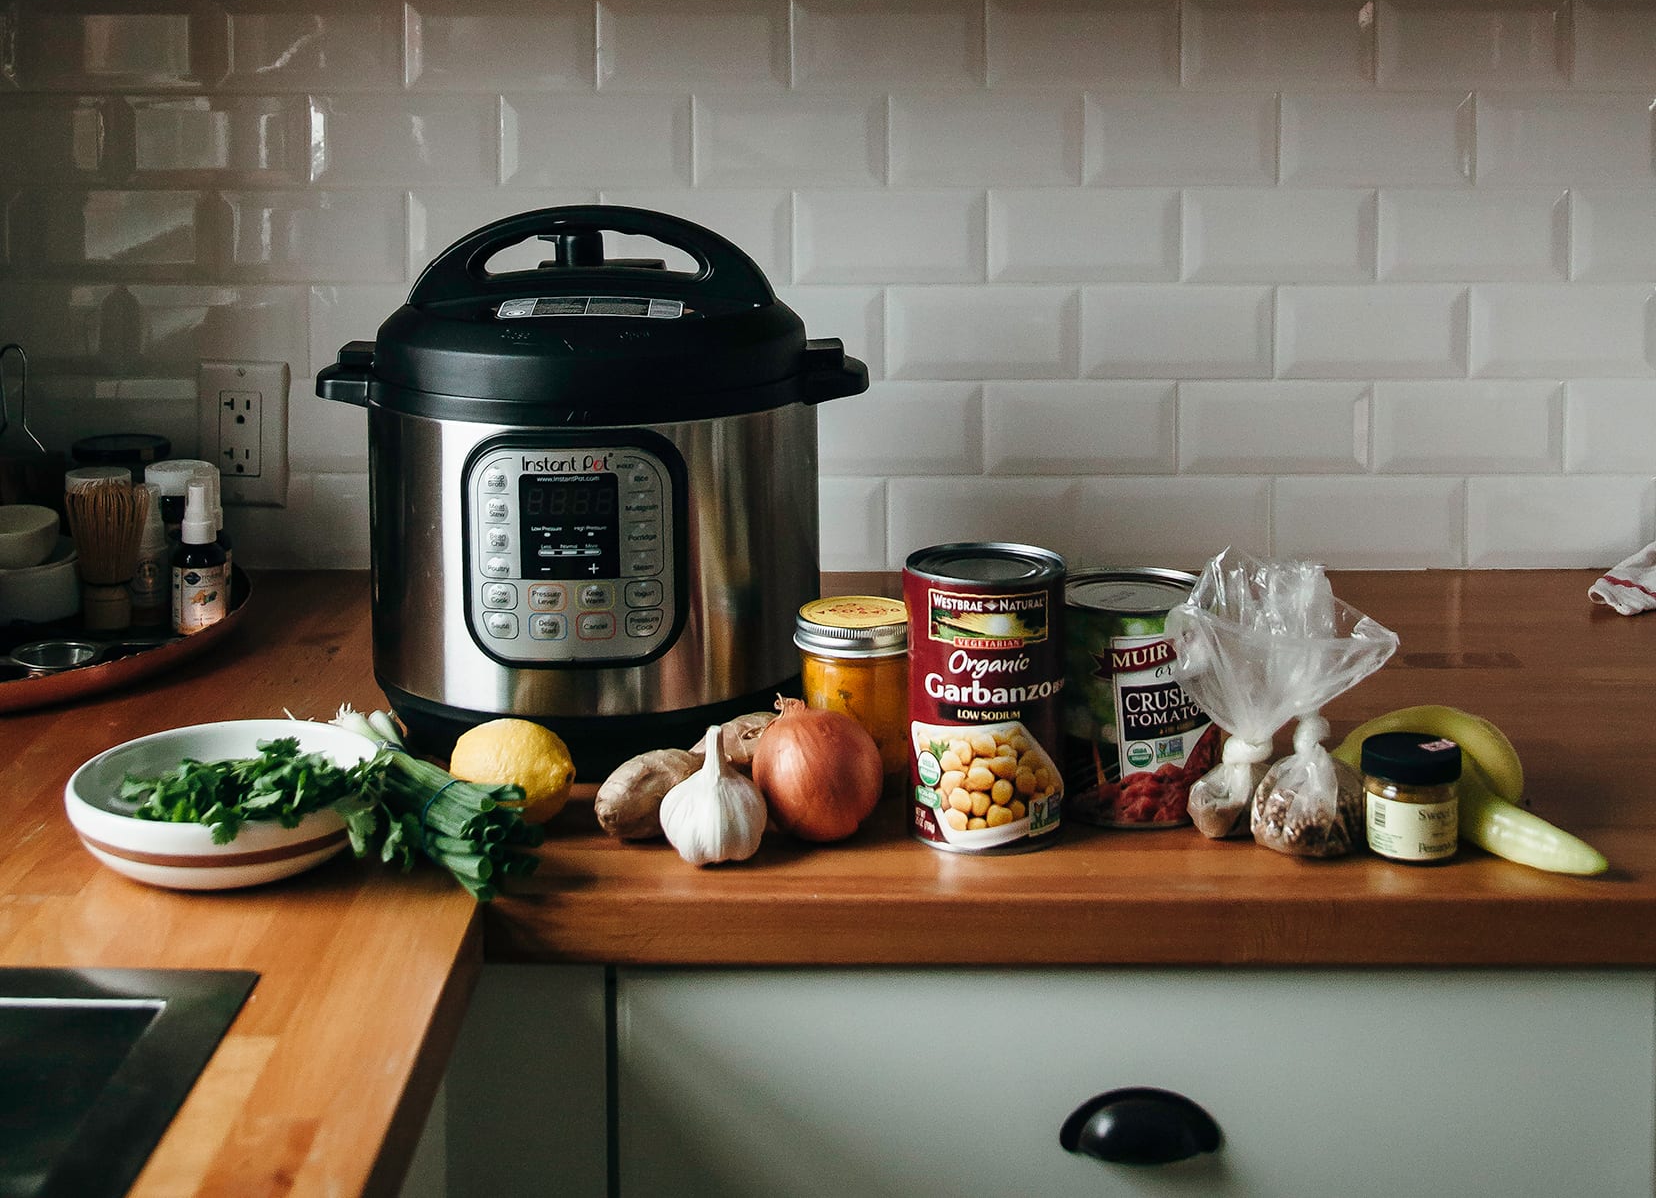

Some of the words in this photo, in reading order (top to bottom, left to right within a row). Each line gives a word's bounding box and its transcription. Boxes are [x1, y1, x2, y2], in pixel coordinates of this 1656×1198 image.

[522, 455, 577, 472] Instant
[582, 455, 610, 472] Pot
[932, 592, 983, 612] WESTBRAE
[1000, 597, 1044, 612] NATURAL
[583, 622, 608, 631] Cancel
[957, 638, 1022, 648] VEGETARIAN
[948, 649, 1031, 680] Organic
[1111, 643, 1168, 668] MUIR
[1155, 665, 1173, 678] or
[924, 672, 1051, 705] Garbanzo
[956, 708, 981, 720] LOW
[981, 708, 1021, 721] SODIUM
[1127, 704, 1200, 727] TOMATO
